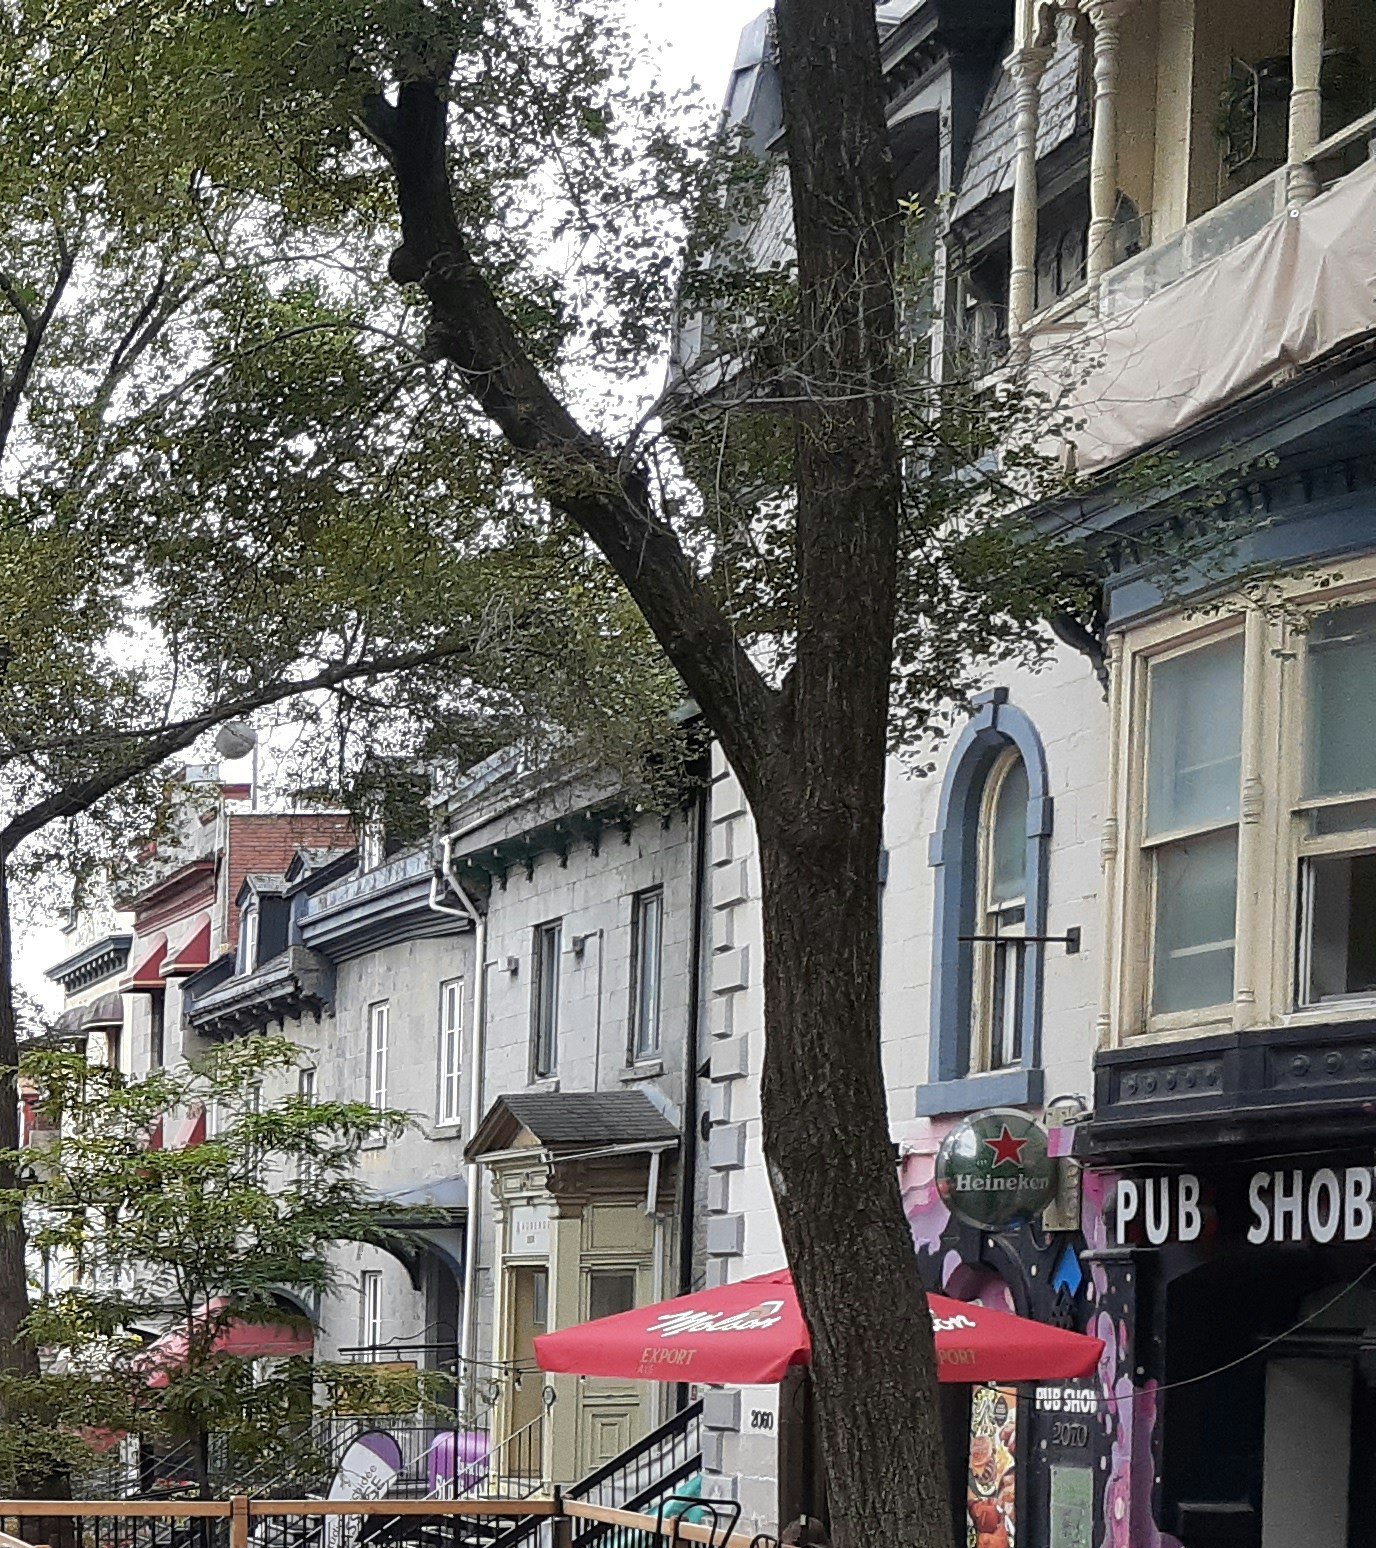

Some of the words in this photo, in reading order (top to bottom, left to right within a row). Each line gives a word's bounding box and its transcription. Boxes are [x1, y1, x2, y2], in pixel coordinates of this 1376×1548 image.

[955, 1173, 1049, 1192] Heineken
[1117, 1174, 1202, 1245] PUB
[1247, 1166, 1376, 1245] SHOB
[646, 1300, 785, 1338] Molson
[640, 1347, 697, 1365] EXPORT
[938, 1348, 977, 1365] PORT
[1035, 1386, 1062, 1411] PUB
[1052, 1421, 1089, 1447] 2070
